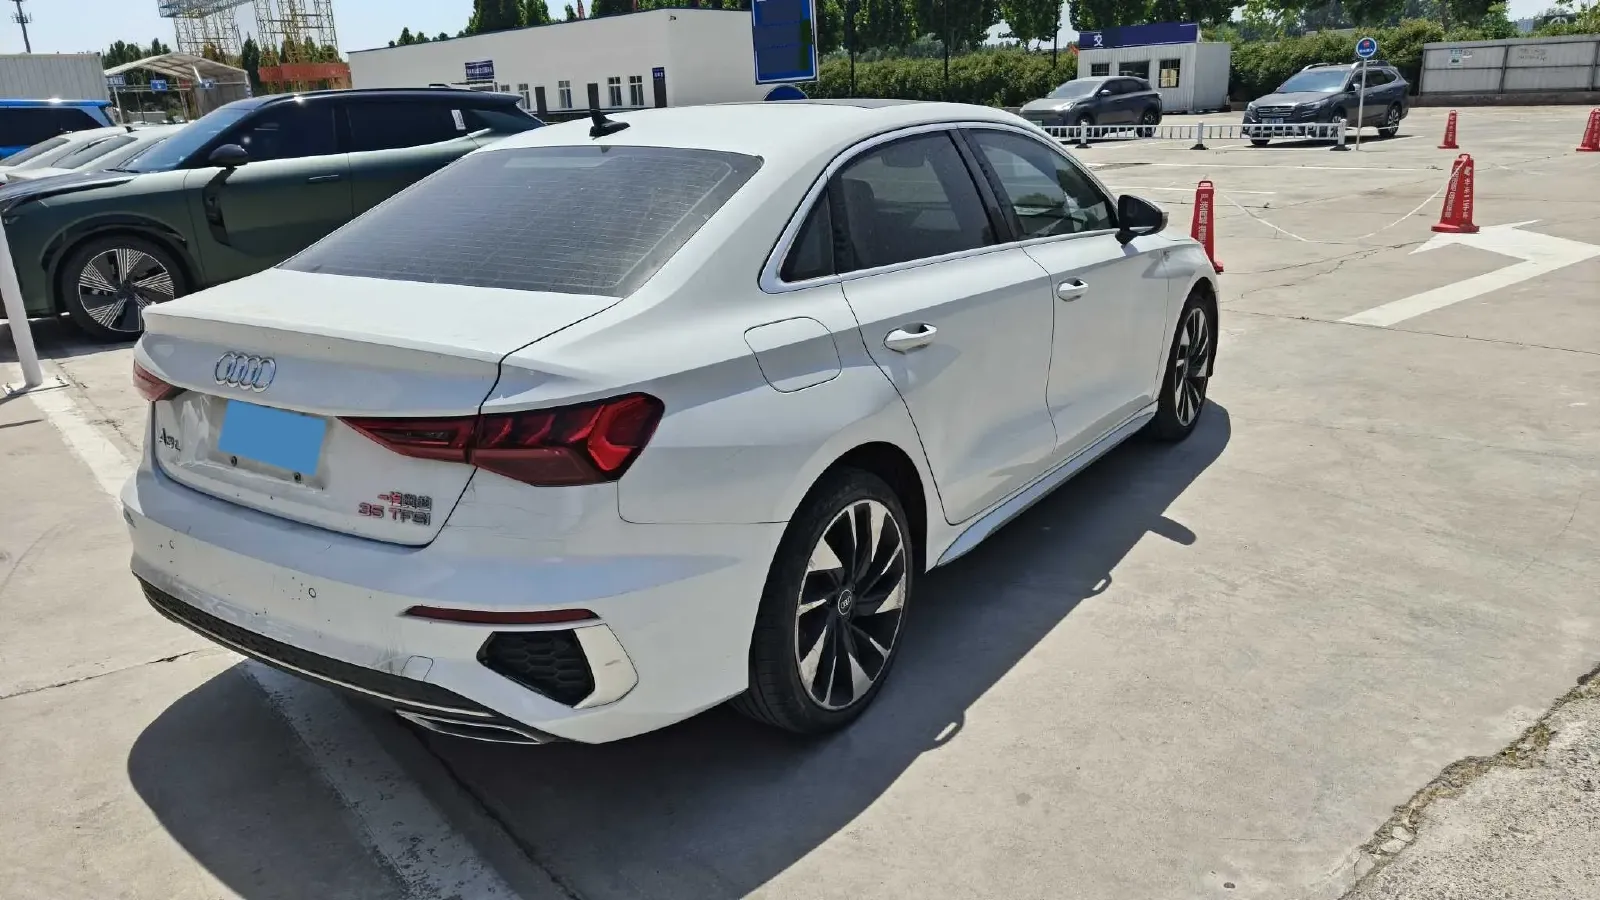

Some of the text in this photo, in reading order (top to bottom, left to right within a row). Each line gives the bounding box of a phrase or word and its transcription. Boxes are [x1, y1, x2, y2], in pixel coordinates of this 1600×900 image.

[1093, 33, 1104, 47] 交
[358, 502, 431, 526] 35 TFSI
